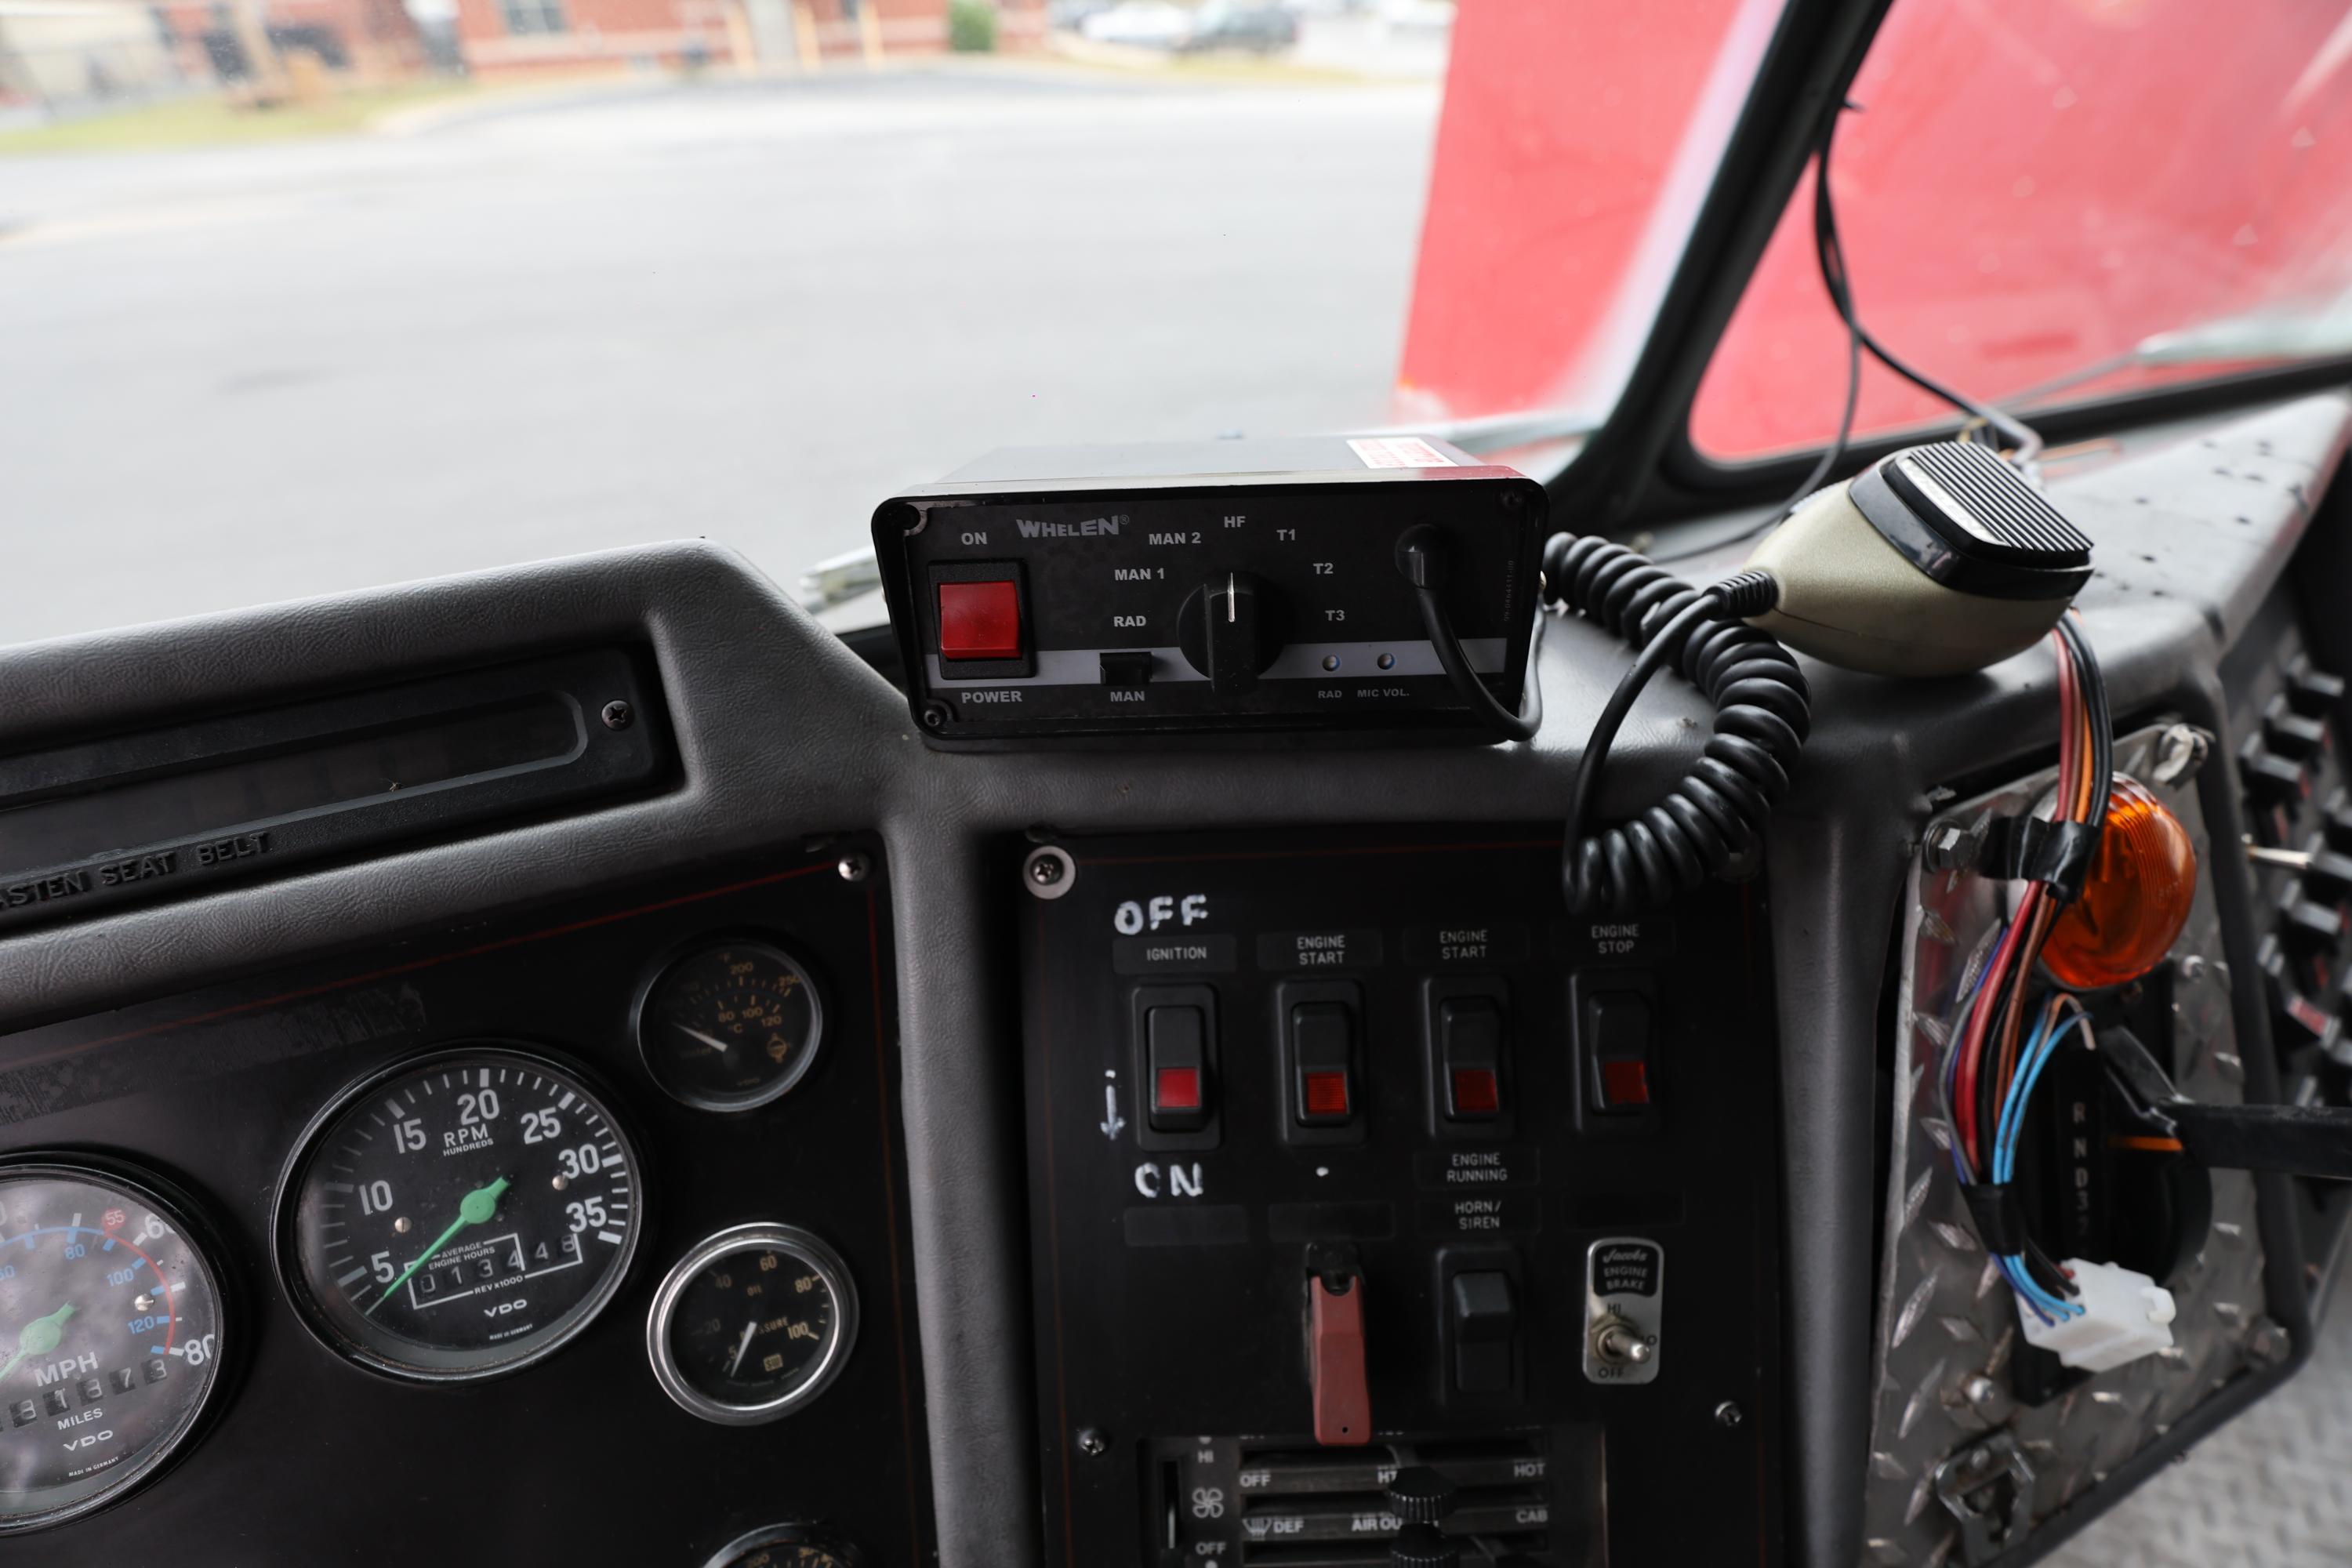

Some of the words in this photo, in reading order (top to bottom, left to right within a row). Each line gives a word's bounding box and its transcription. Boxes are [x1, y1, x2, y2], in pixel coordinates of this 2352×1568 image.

[1223, 515, 1247, 529] HF
[961, 532, 988, 546] ON
[1149, 532, 1185, 546] MAN
[1190, 532, 1202, 545] 2
[1276, 528, 1297, 542] T1
[1114, 568, 1151, 581] MAN
[1157, 567, 1165, 580] 1
[1313, 562, 1334, 575] T2
[1113, 615, 1146, 628] RAD
[1326, 608, 1345, 622] T3
[961, 690, 1022, 704] POWER
[1109, 690, 1145, 703] MAN
[1318, 689, 1342, 699] RAD
[1357, 688, 1379, 699] MIC
[1381, 688, 1410, 699] VOL.
[100, 851, 178, 887] SEAT
[197, 832, 271, 866] BELT
[1114, 895, 1208, 935] OFF
[1439, 930, 1487, 945] ENGINE
[1592, 924, 1639, 939] ENGINE
[1297, 935, 1345, 950] ENGINE
[1598, 940, 1635, 954] STOP
[1146, 946, 1207, 961] IGNITION
[1298, 951, 1345, 965] START
[1442, 946, 1487, 960] START
[742, 1007, 764, 1018] 100
[456, 1088, 500, 1125] 20
[2073, 1102, 2085, 1124] R
[520, 1107, 562, 1145] 25
[393, 1118, 426, 1155] 15
[444, 1123, 489, 1148] RPM
[443, 1138, 494, 1157] HUNDREDS
[2074, 1138, 2087, 1160] N
[558, 1144, 600, 1180] 30
[1452, 1152, 1501, 1167] ENGINE
[1446, 1168, 1508, 1183] RUNNING
[2075, 1167, 2089, 1189] D
[358, 1180, 394, 1216] 10
[565, 1196, 608, 1233] 35
[1454, 1200, 1502, 1215] HORN/
[106, 1210, 125, 1225] 55
[1458, 1216, 1501, 1231] SIREN
[65, 1243, 85, 1261] 80
[441, 1241, 482, 1259] AVERAGE
[371, 1250, 394, 1283] 5
[428, 1255, 462, 1271] ENGINE
[463, 1247, 495, 1261] HOURS
[760, 1254, 778, 1271] 60
[107, 1268, 134, 1287] 100
[1603, 1265, 1648, 1278] ENGINE
[474, 1283, 493, 1295] REV
[794, 1276, 813, 1294] 80
[1606, 1279, 1646, 1290] BRAKE
[484, 1299, 528, 1318] VDO
[1607, 1302, 1622, 1314] HI
[129, 1316, 155, 1334] 120
[787, 1321, 810, 1340] 100
[34, 1351, 100, 1388] MPH
[56, 1407, 103, 1430] MILES
[64, 1429, 114, 1451] VDO
[1197, 1450, 1214, 1464] HI
[68, 1468, 84, 1477] MADE
[93, 1456, 118, 1470] GERMANY
[1239, 1472, 1271, 1487] OFF
[1377, 1469, 1398, 1484] HT
[1514, 1462, 1546, 1477] HOT
[1273, 1519, 1305, 1534] DEF
[1352, 1518, 1377, 1532] AIR
[1380, 1517, 1403, 1531] OU
[1516, 1508, 1548, 1523] CAB
[1196, 1541, 1227, 1555] OFF
